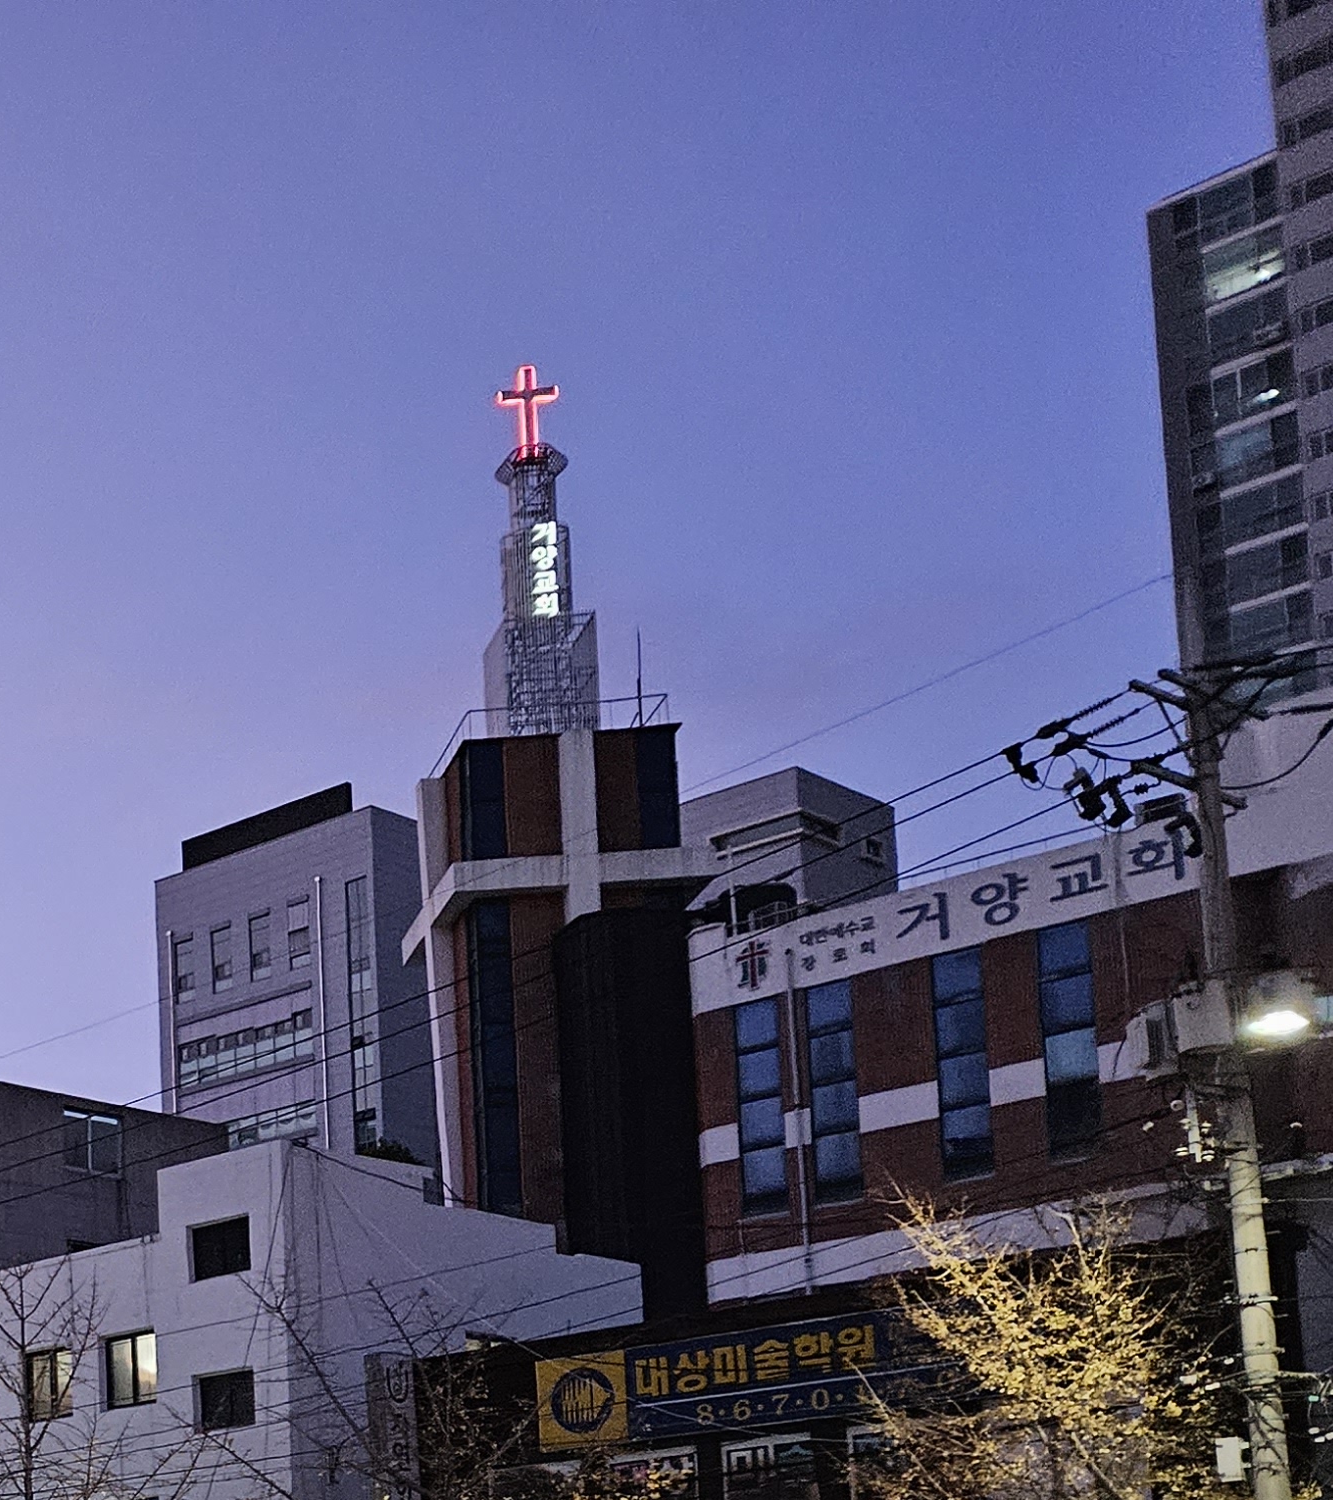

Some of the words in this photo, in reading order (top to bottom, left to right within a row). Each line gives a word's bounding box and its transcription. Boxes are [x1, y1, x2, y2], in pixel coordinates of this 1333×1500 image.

[531, 521, 560, 619] 거양교회
[897, 829, 1185, 940] 거양교회
[799, 916, 876, 946] 대한예수교
[635, 1324, 877, 1397] 대상미술학원
